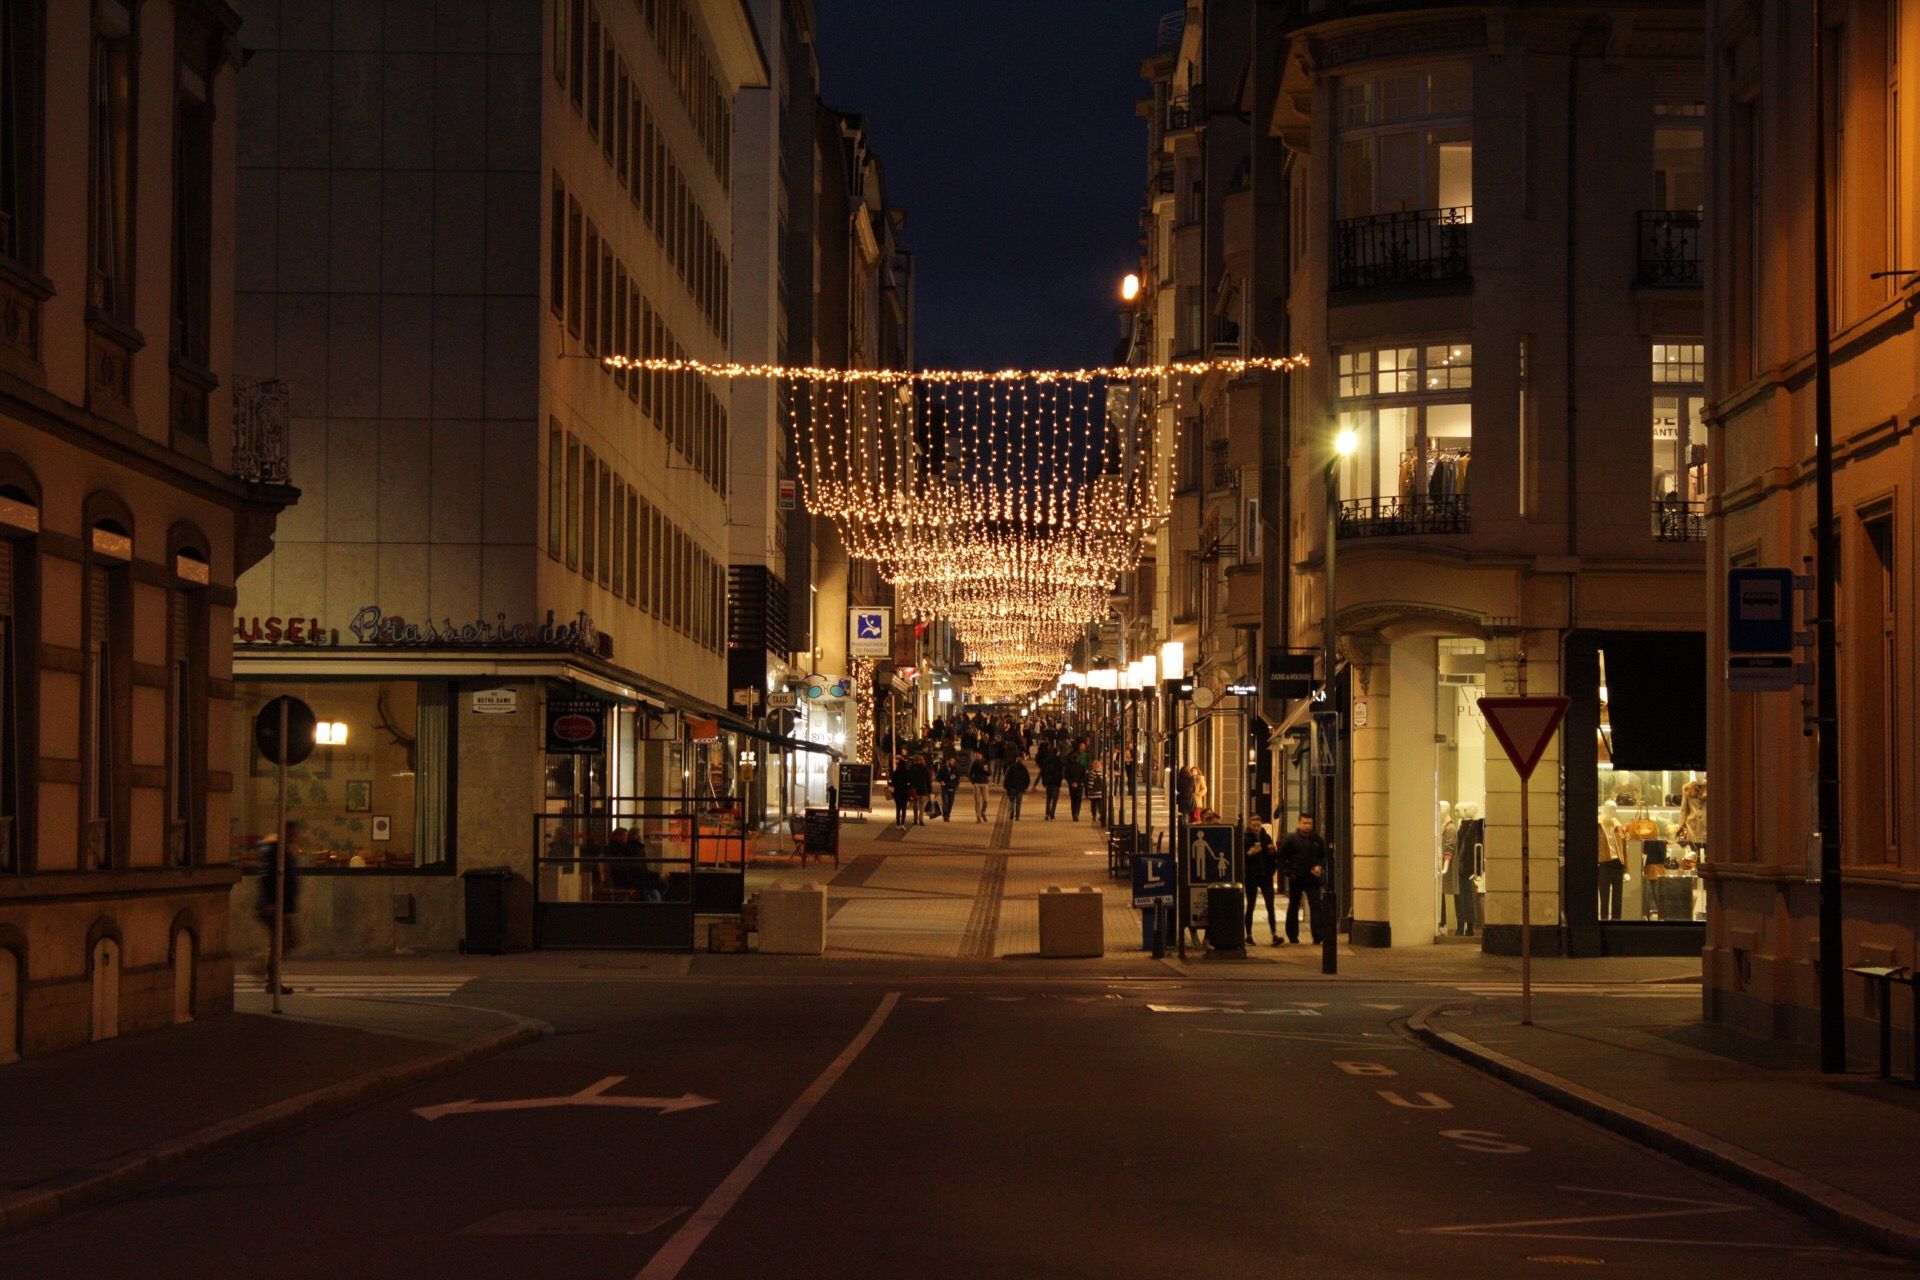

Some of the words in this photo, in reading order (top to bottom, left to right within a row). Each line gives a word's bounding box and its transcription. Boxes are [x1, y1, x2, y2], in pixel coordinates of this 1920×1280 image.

[350, 606, 525, 645] Brasserie
[772, 695, 788, 704] TAXIS
[1332, 1060, 1532, 1153] BUS
